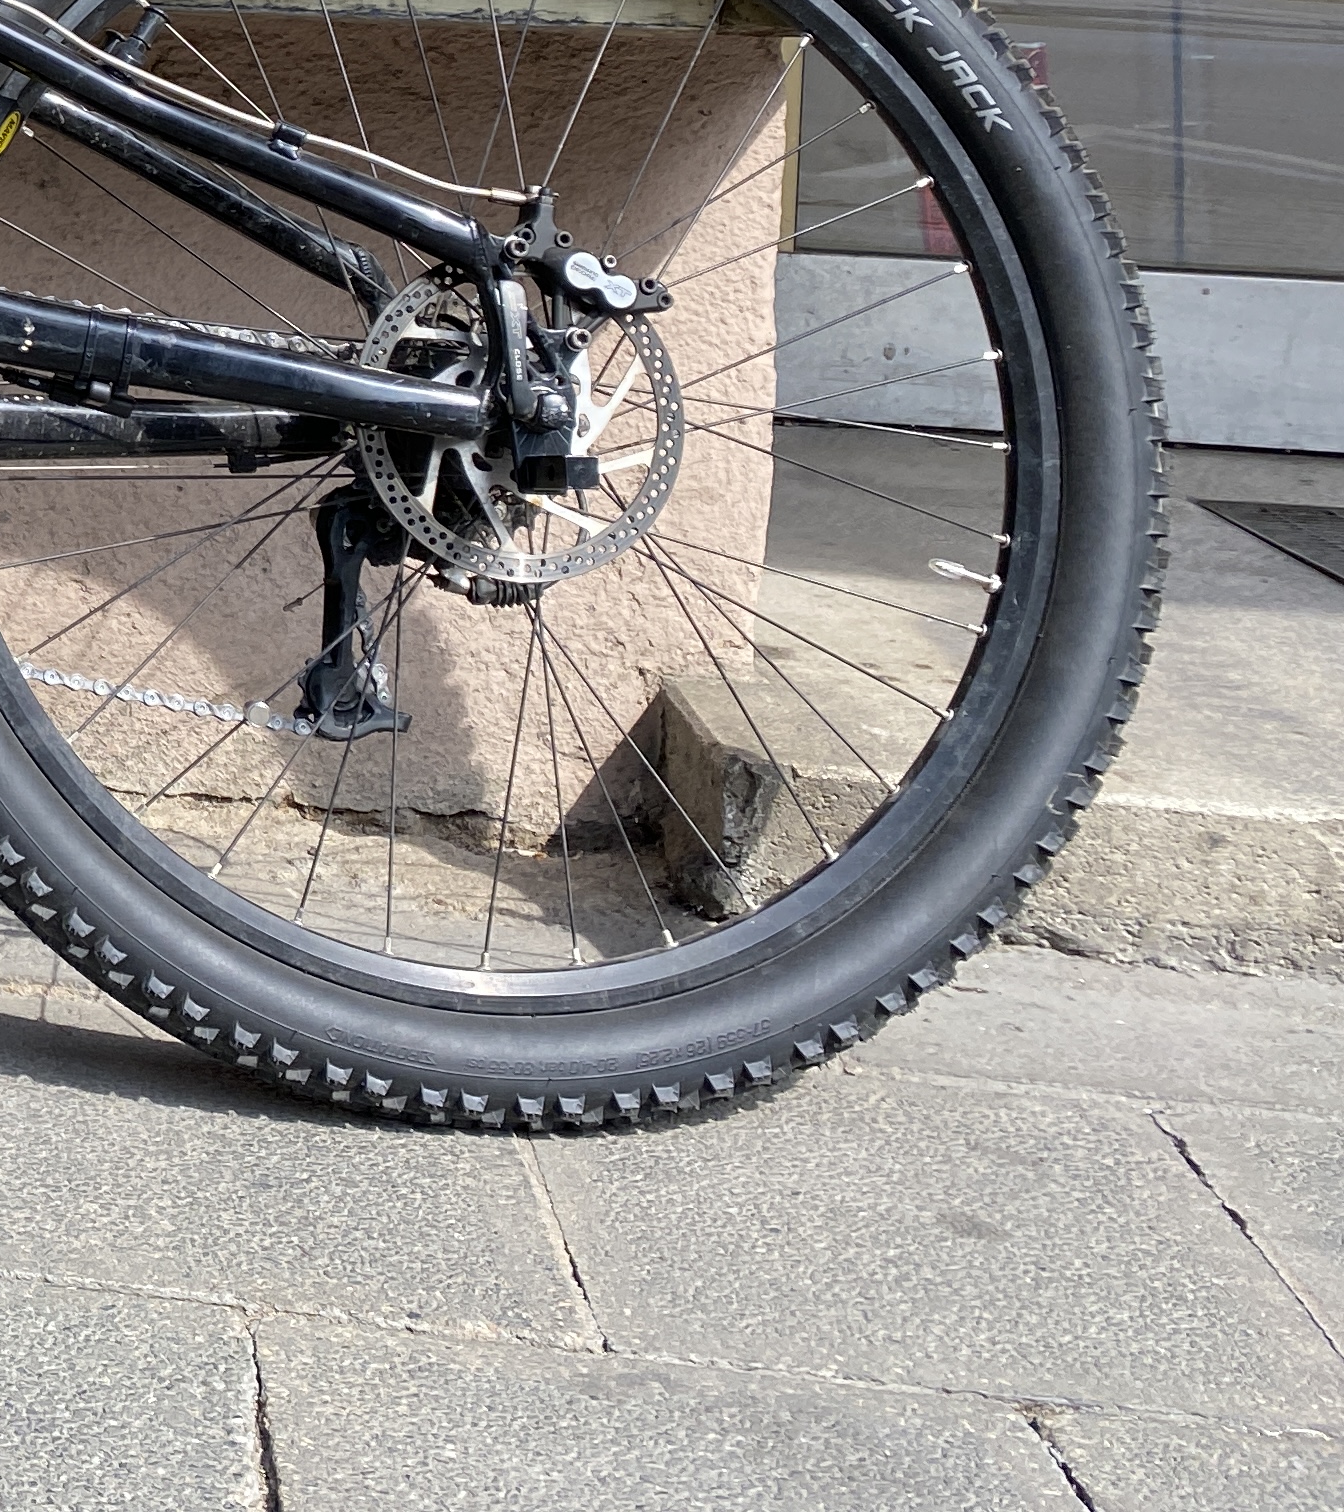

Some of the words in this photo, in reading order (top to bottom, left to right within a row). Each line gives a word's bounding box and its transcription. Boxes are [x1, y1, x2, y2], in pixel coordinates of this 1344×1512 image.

[926, 46, 1014, 133] JACK
[603, 279, 633, 298] XT
[510, 310, 522, 340] XT
[513, 348, 523, 381] CLOSE
